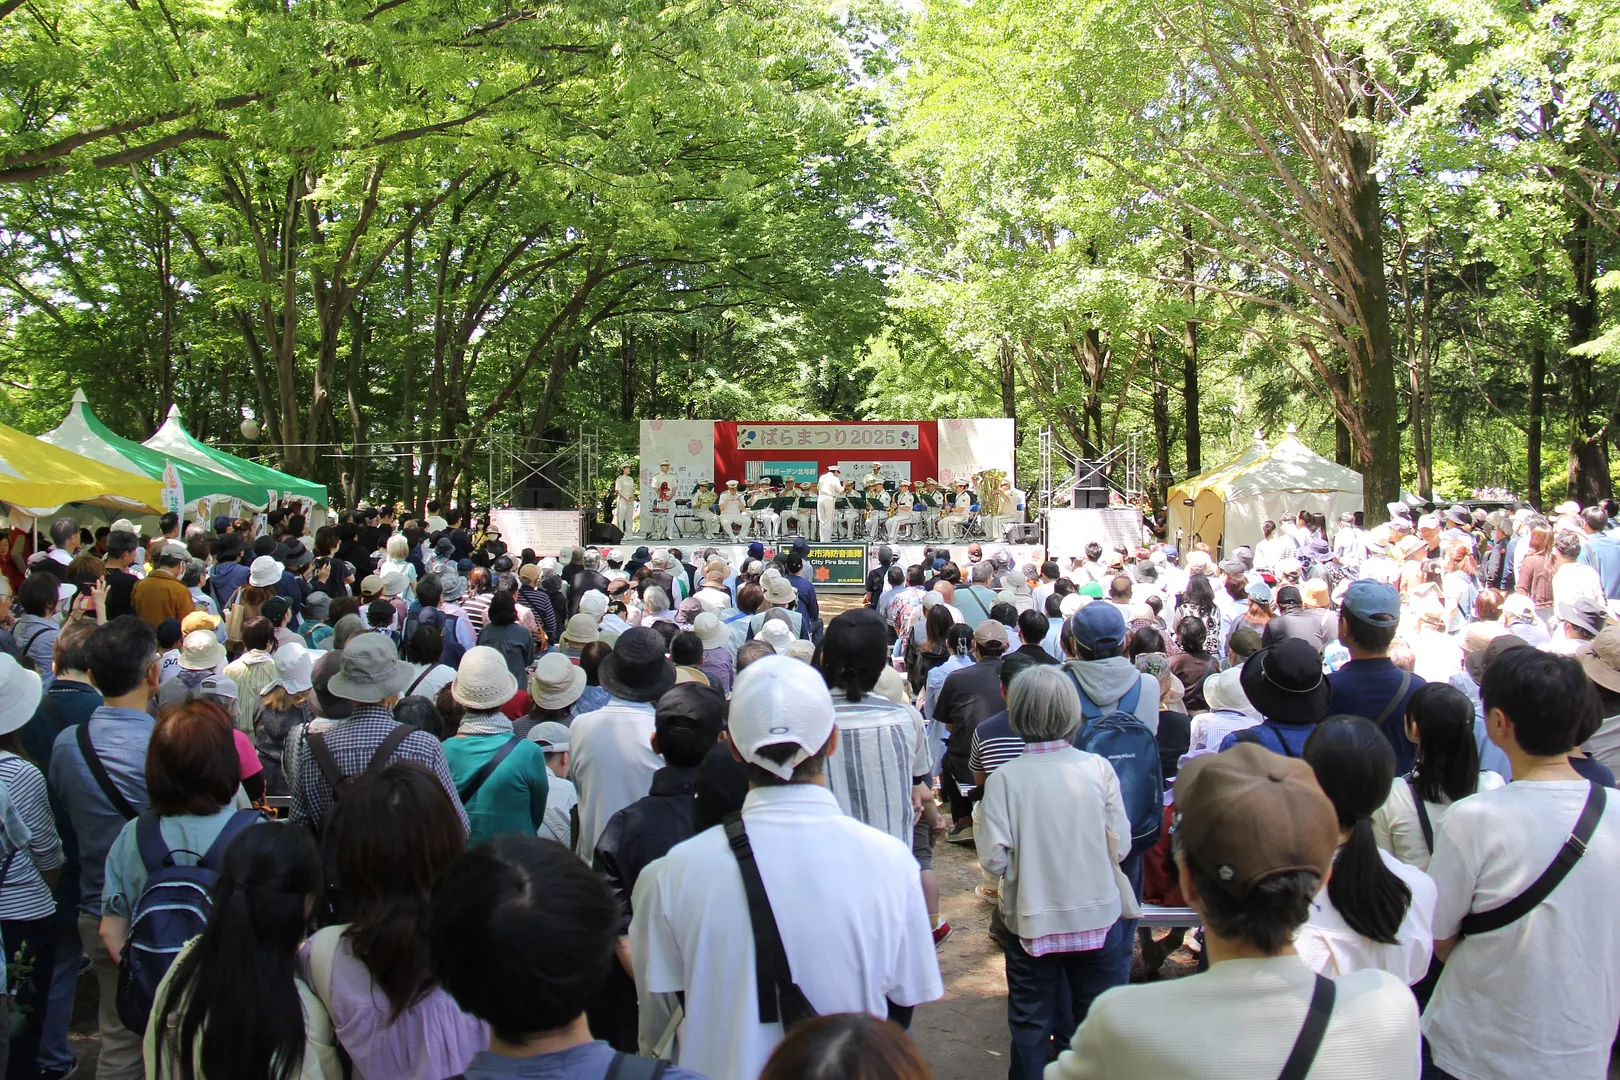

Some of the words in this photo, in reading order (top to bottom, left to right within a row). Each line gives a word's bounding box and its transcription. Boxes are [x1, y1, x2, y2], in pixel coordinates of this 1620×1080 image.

[760, 428, 896, 446] ばらまつり2025
